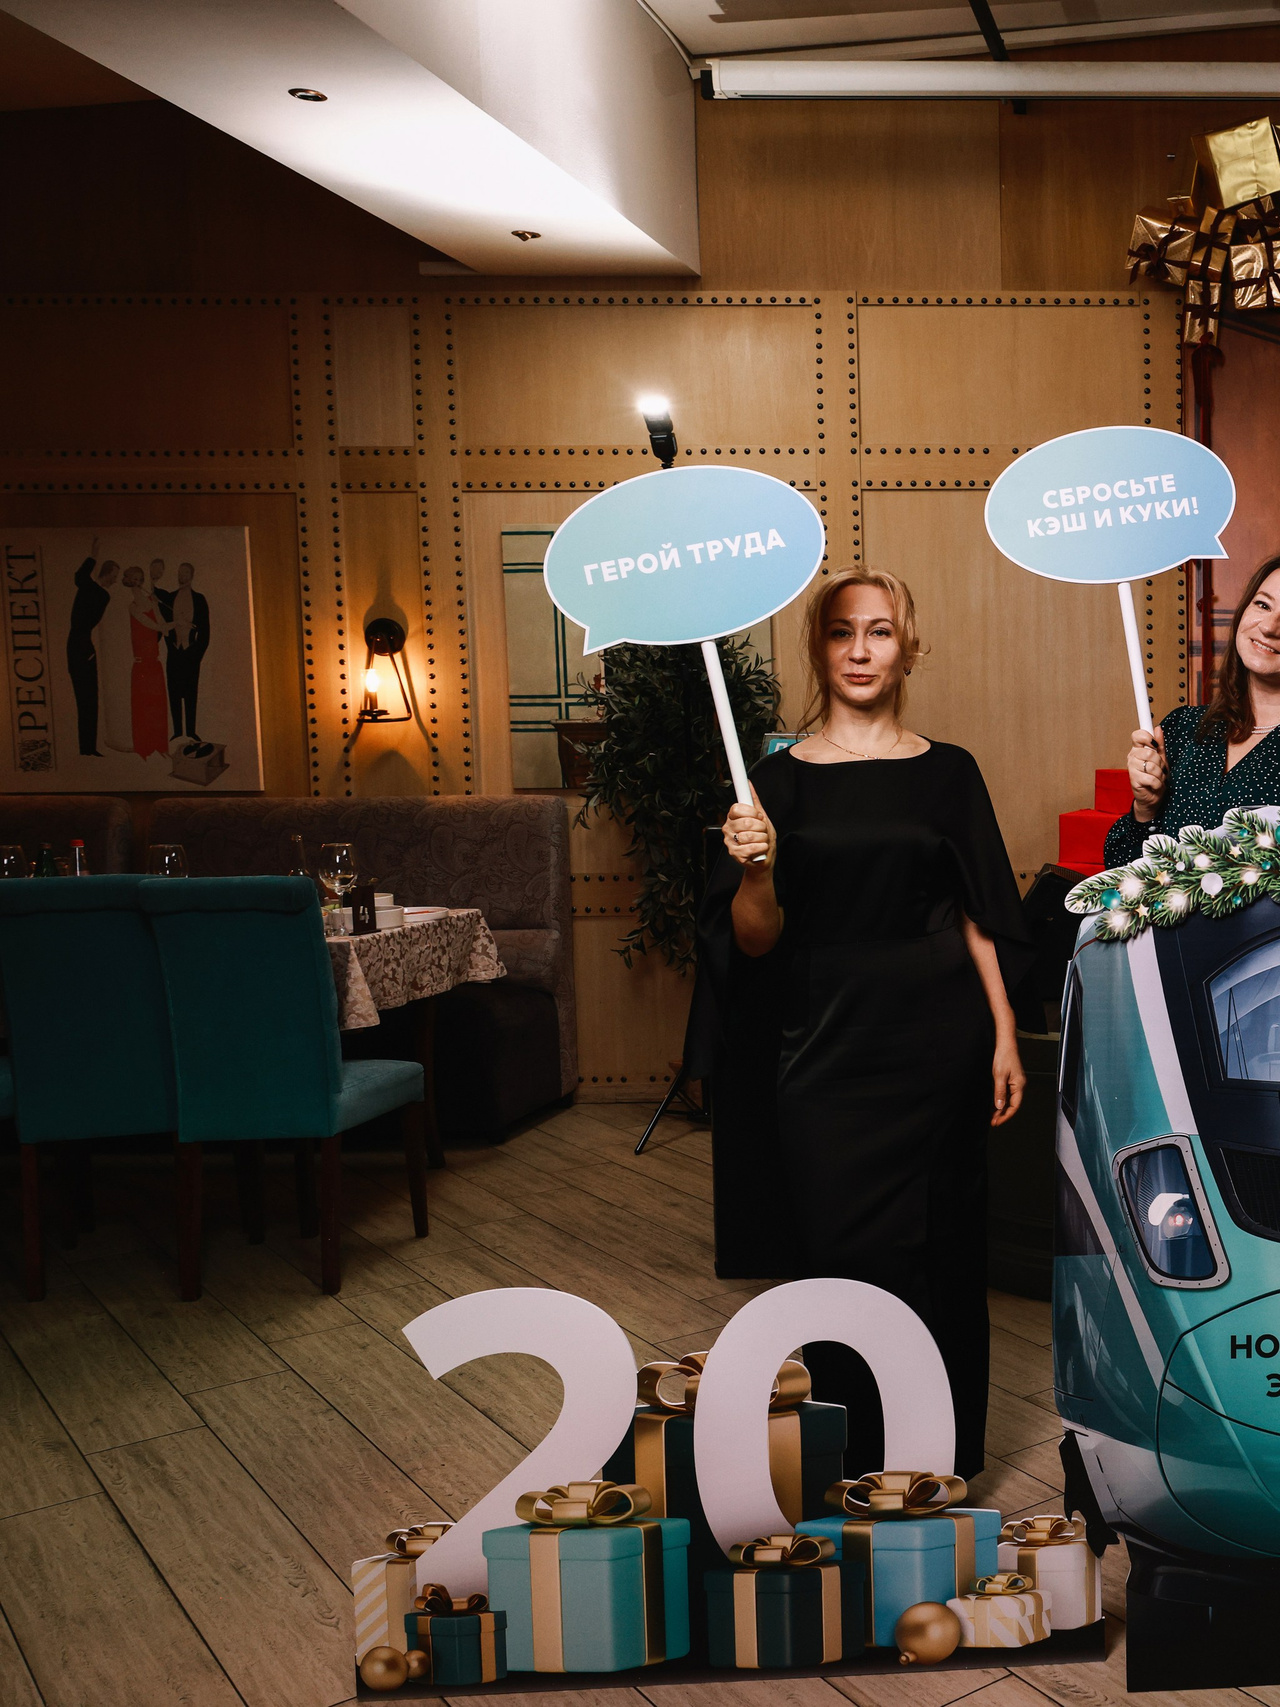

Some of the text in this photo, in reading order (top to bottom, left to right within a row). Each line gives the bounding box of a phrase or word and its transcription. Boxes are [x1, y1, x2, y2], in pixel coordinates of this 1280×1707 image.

[1042, 473, 1177, 509] СБРОСЬТЕ
[1026, 496, 1200, 538] КЭШ И КУКИ!
[583, 528, 787, 586] ГЕРОЙ ТРУДА
[359, 905, 370, 924] 4
